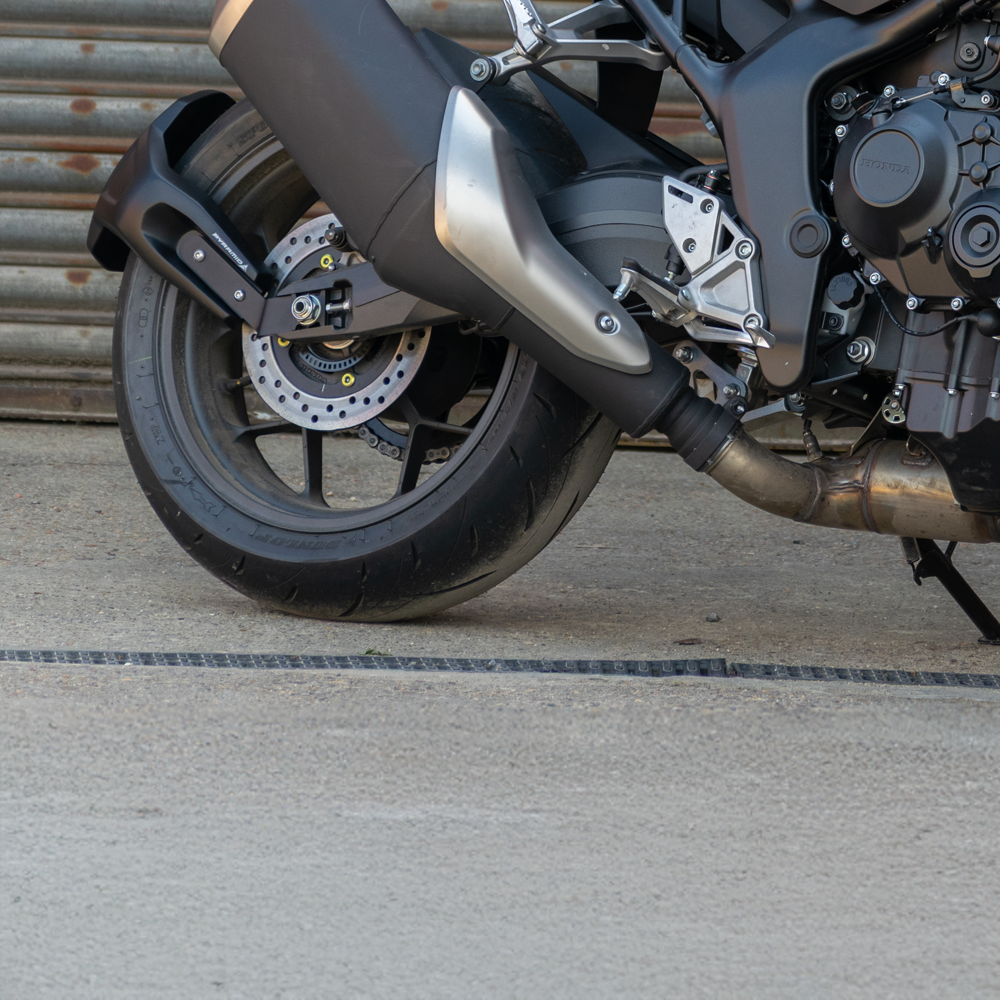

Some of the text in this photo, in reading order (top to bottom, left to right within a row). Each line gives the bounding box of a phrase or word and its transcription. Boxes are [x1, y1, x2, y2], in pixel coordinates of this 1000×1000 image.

[861, 158, 914, 176] HONDA
[212, 232, 244, 266] PYRAMID
[254, 532, 342, 551] DUNLOP
